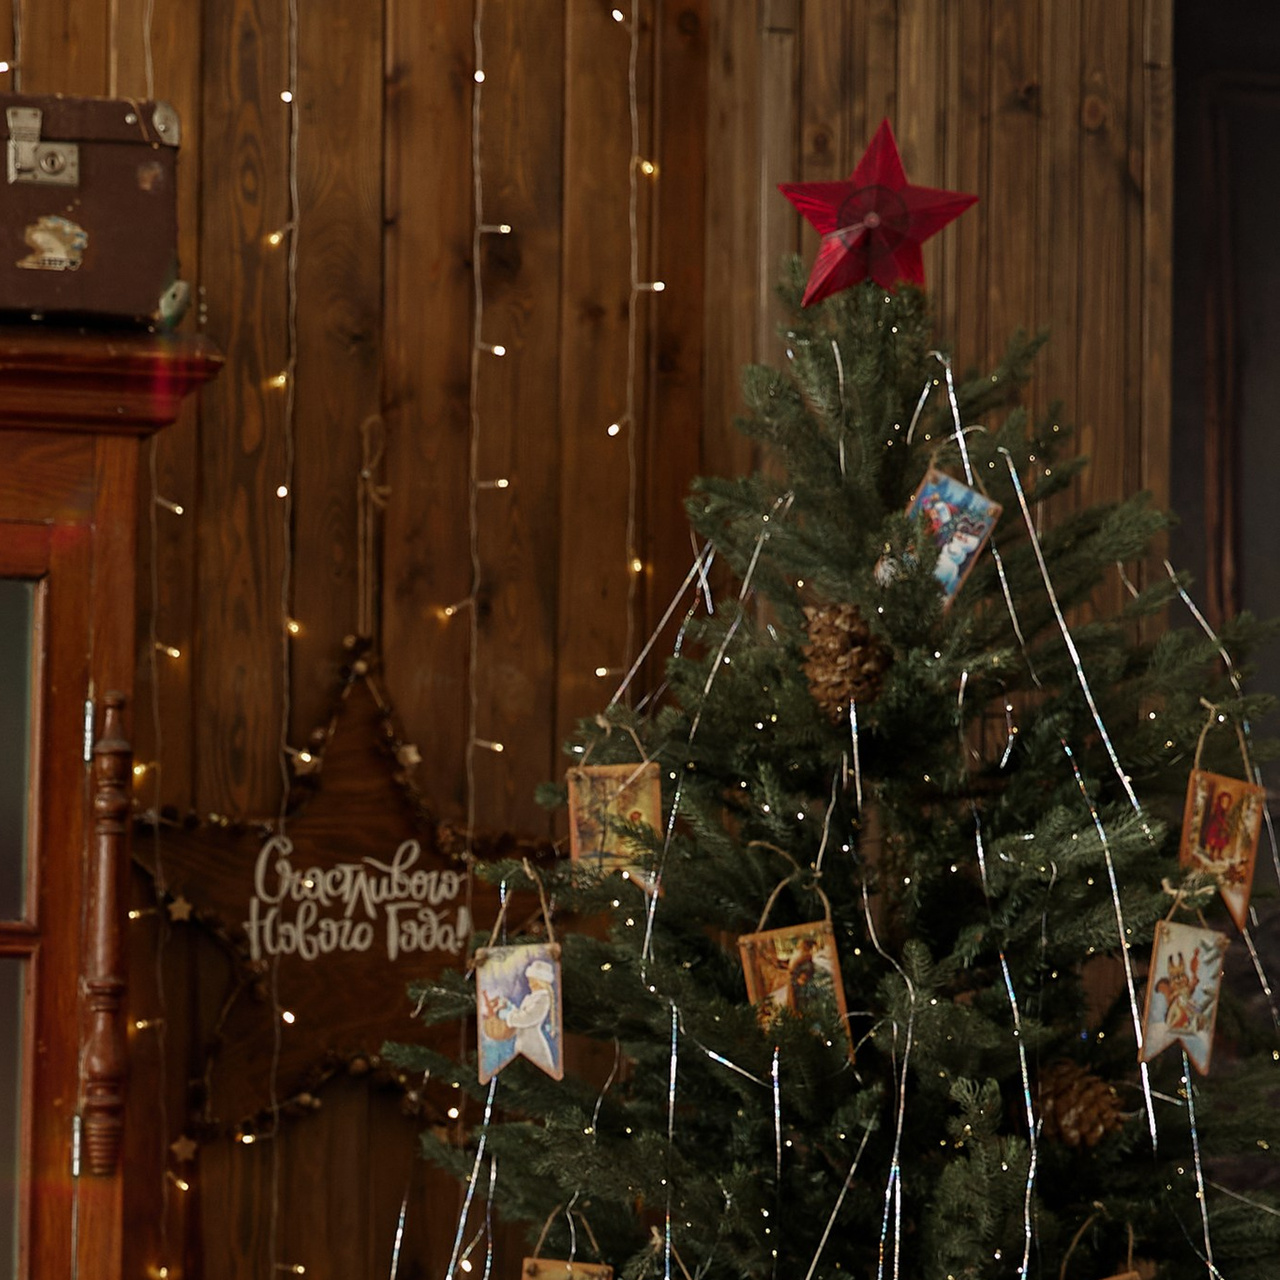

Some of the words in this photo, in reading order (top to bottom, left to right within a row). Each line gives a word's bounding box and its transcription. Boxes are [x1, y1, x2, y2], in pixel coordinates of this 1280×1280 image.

[254, 835, 468, 919] Счастливого
[242, 897, 374, 961] Нового
[385, 901, 470, 961] Года!
